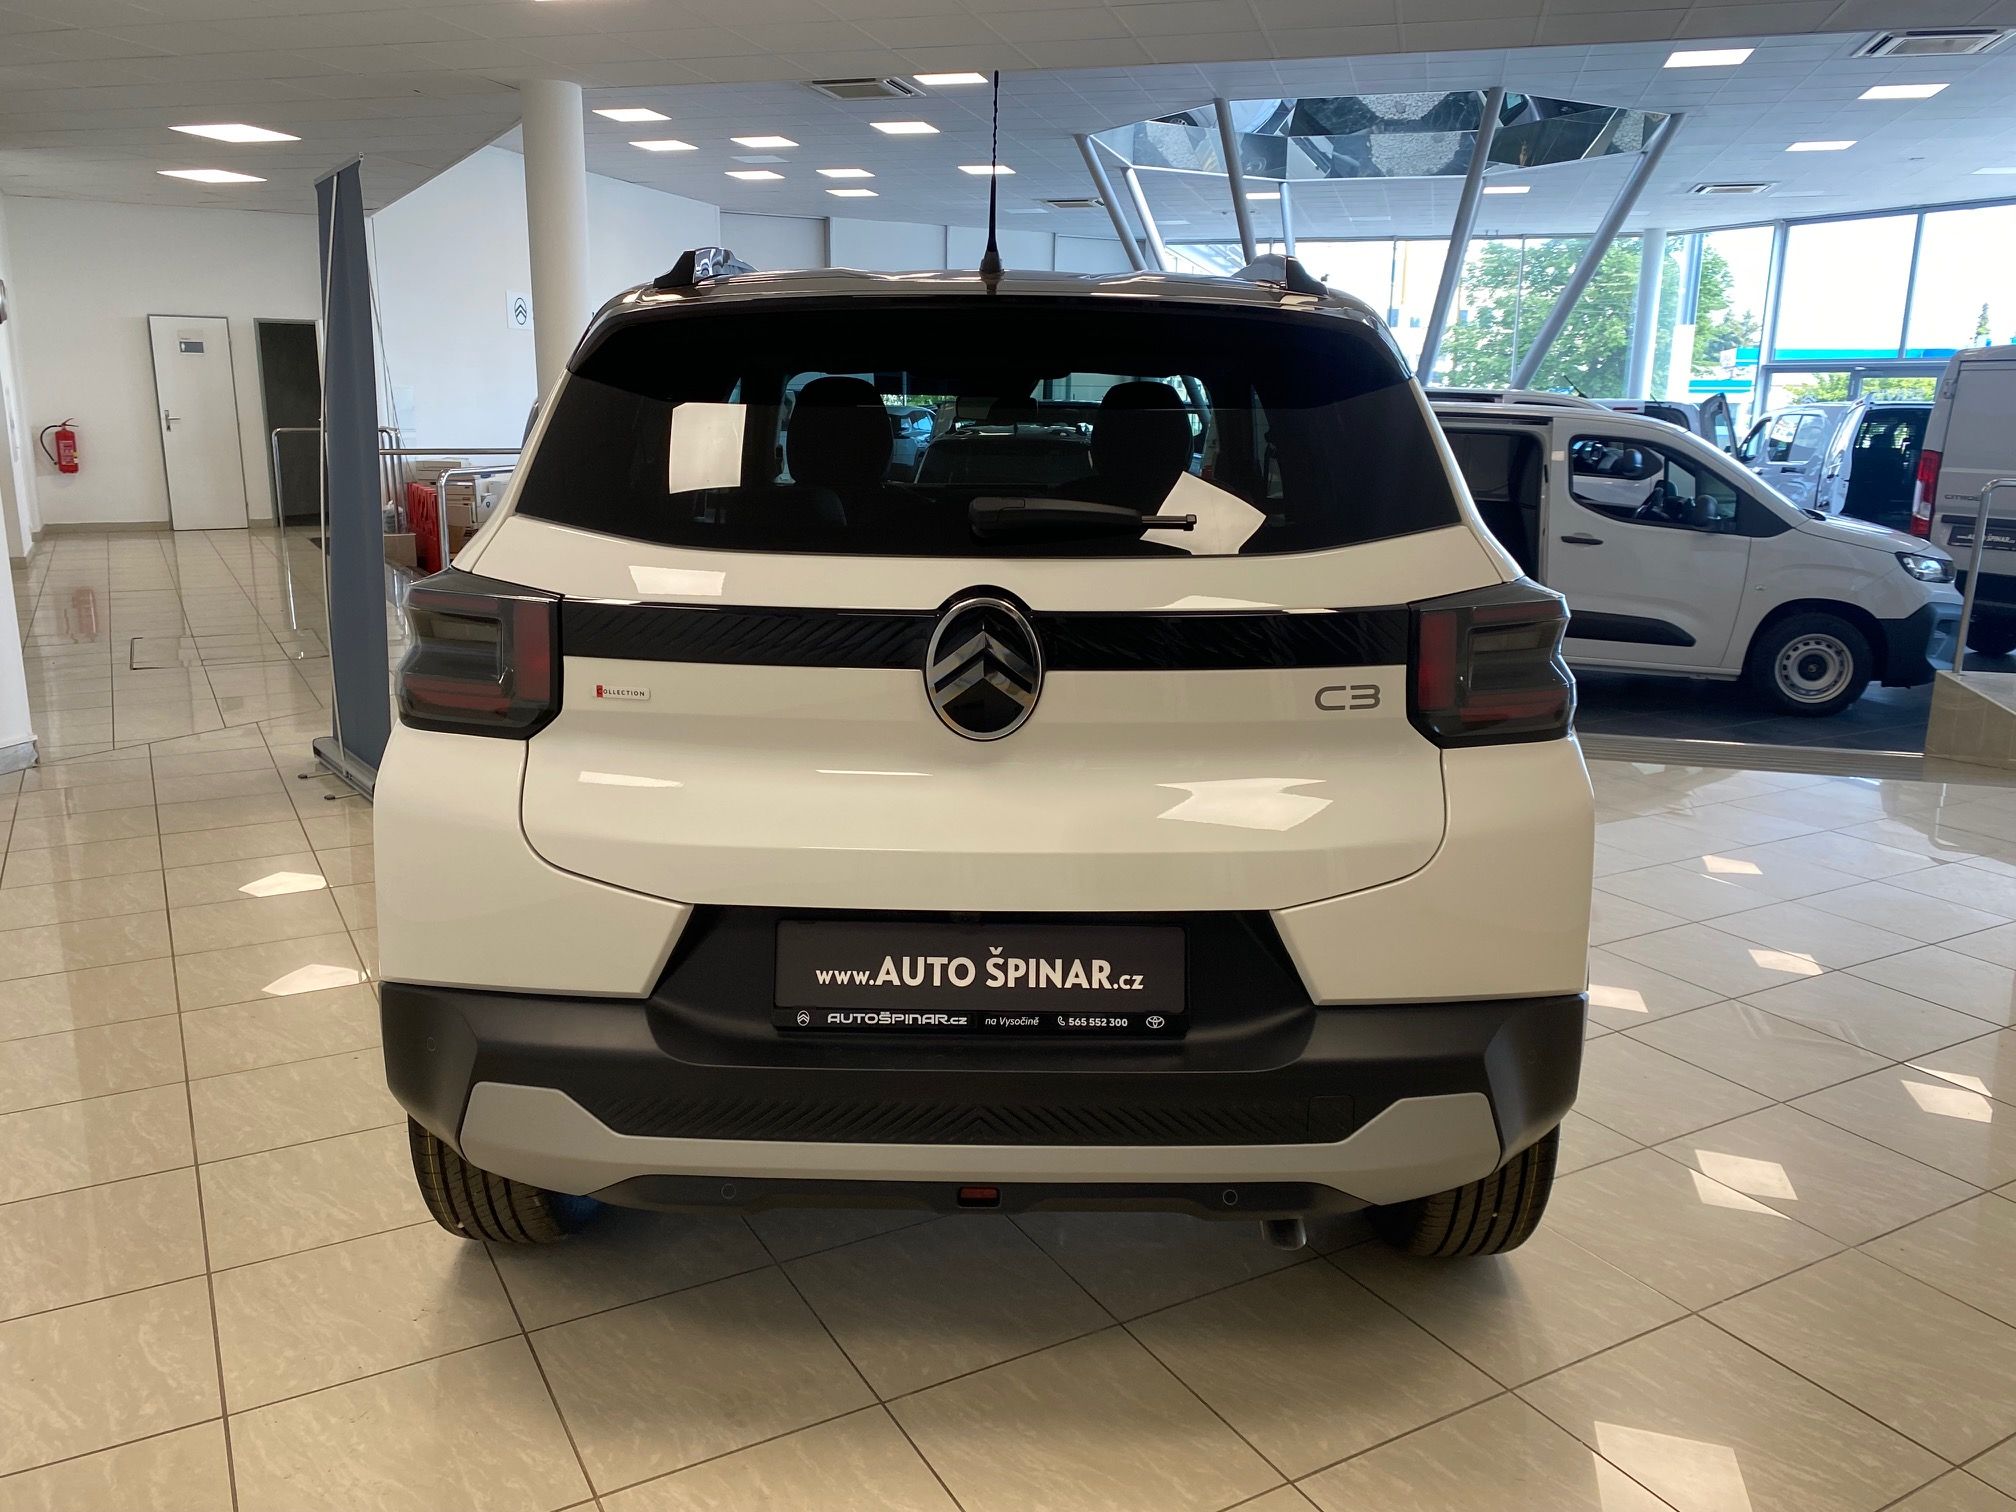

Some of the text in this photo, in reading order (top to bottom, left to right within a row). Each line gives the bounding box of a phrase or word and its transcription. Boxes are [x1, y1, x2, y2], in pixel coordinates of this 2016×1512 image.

[596, 687, 645, 697] COLLECTION
[1315, 684, 1381, 711] C3
[815, 947, 1144, 990] www.AUTO ŠPINAR.cz
[985, 1016, 1040, 1028] na Vysočině
[1068, 1017, 1128, 1027] 565 552 300
